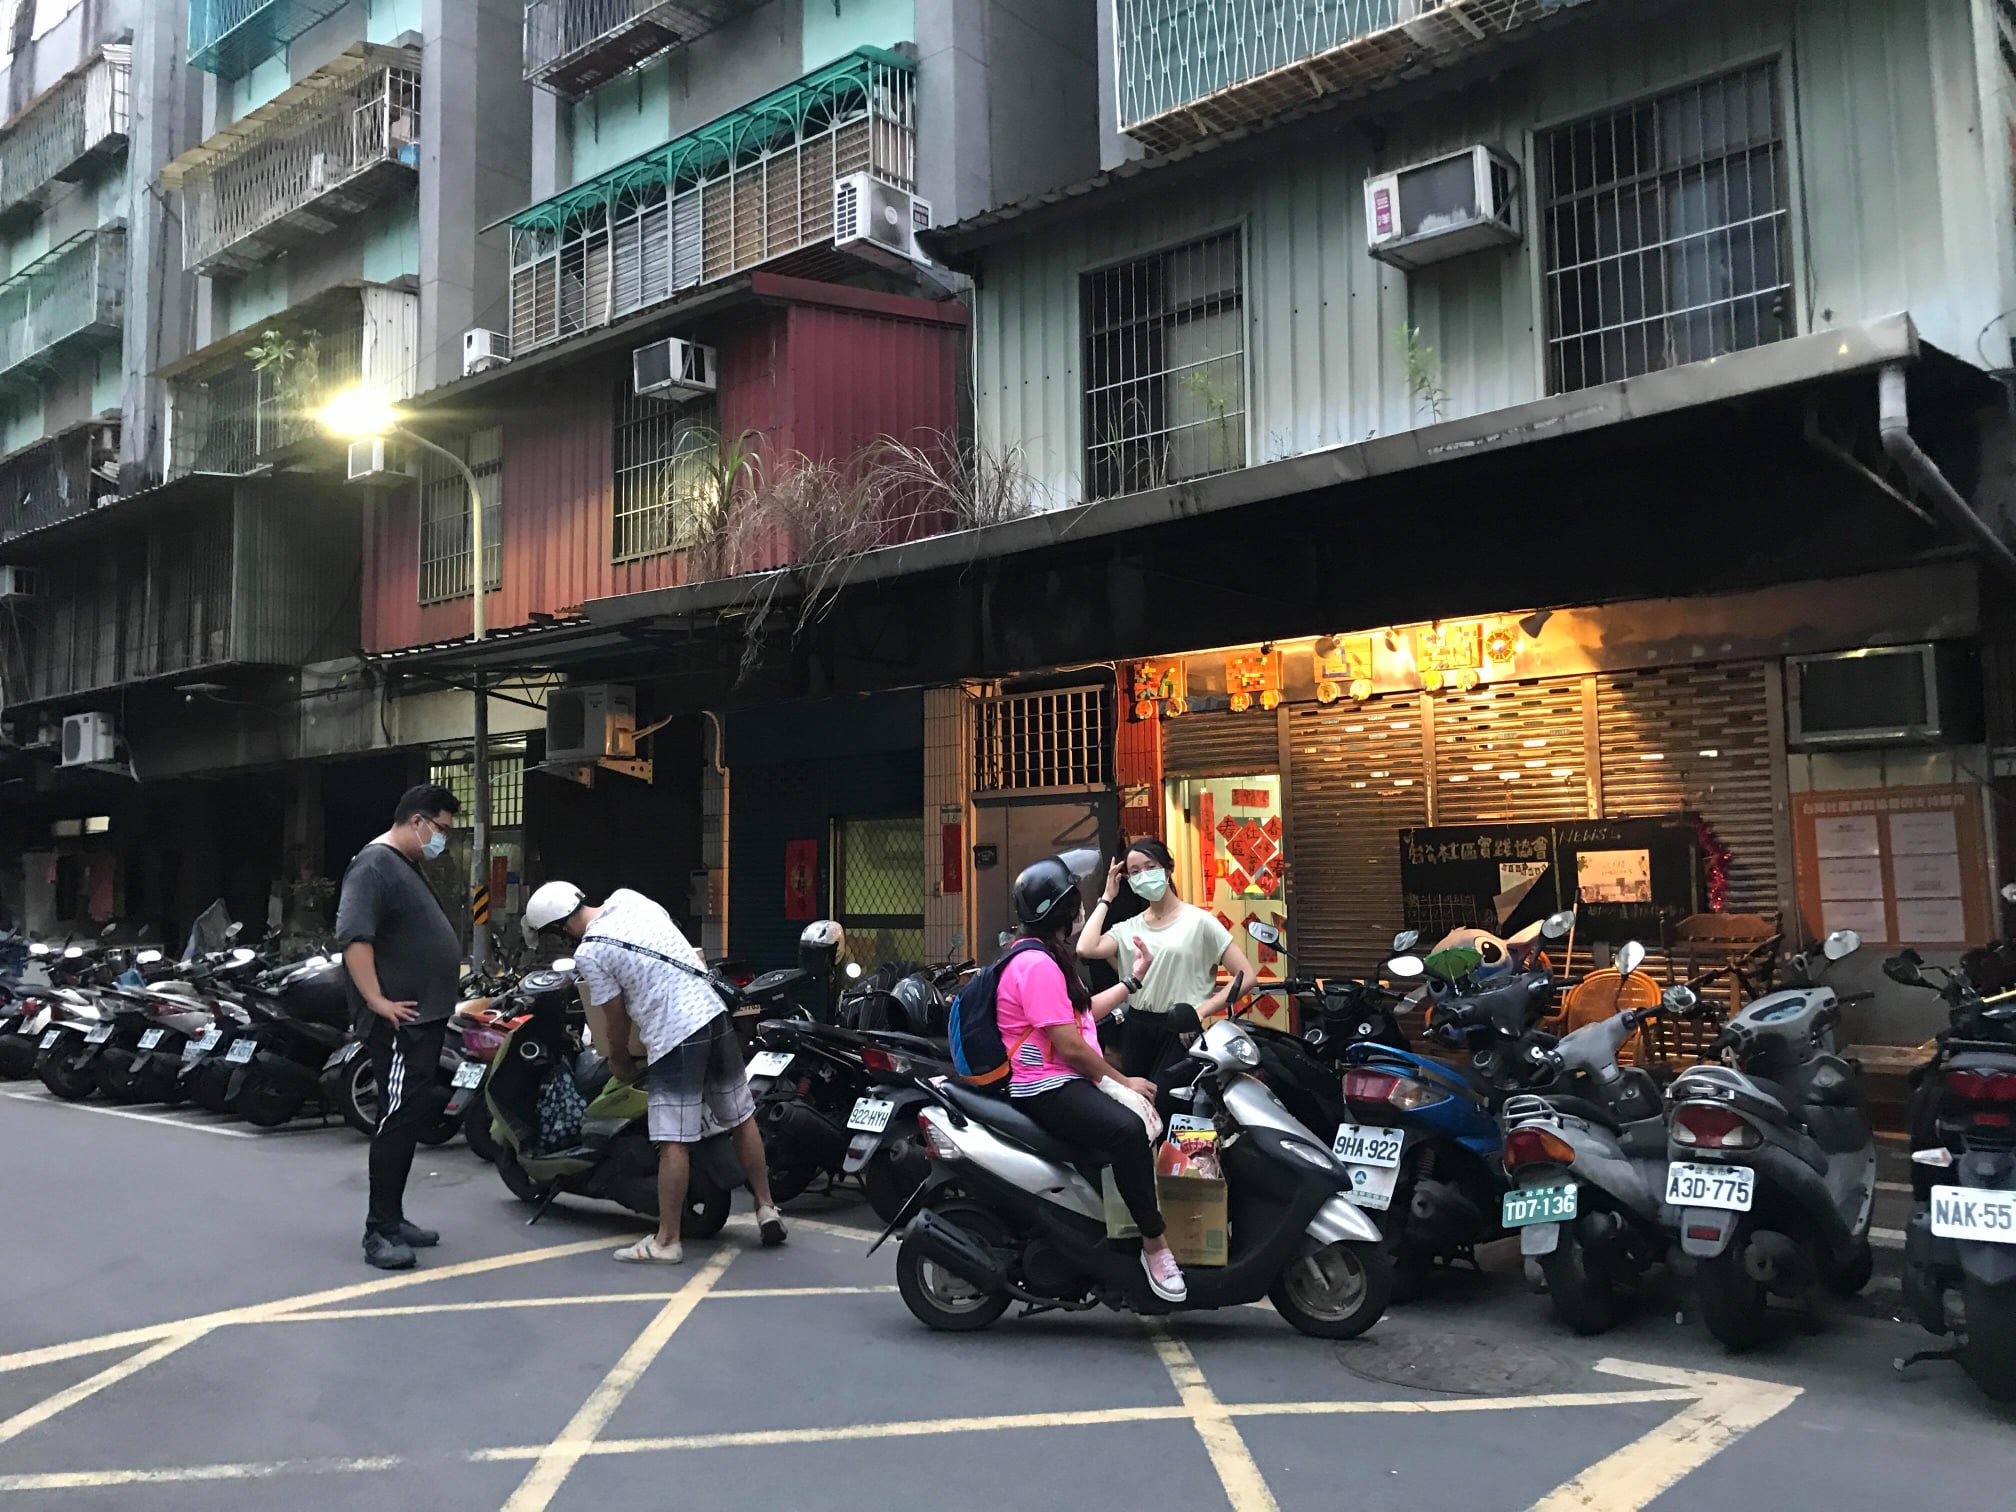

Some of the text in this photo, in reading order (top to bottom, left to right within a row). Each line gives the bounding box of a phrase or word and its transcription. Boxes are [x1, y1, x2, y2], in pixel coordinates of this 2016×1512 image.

[599, 937, 624, 948] adidas
[637, 947, 662, 960] adidas
[674, 960, 696, 974] adidas
[850, 1108, 889, 1127] 922-HYH
[1335, 1136, 1399, 1161] 9HA-922
[1669, 1177, 1749, 1204] A3D-775
[1505, 1195, 1575, 1222] TD7-136
